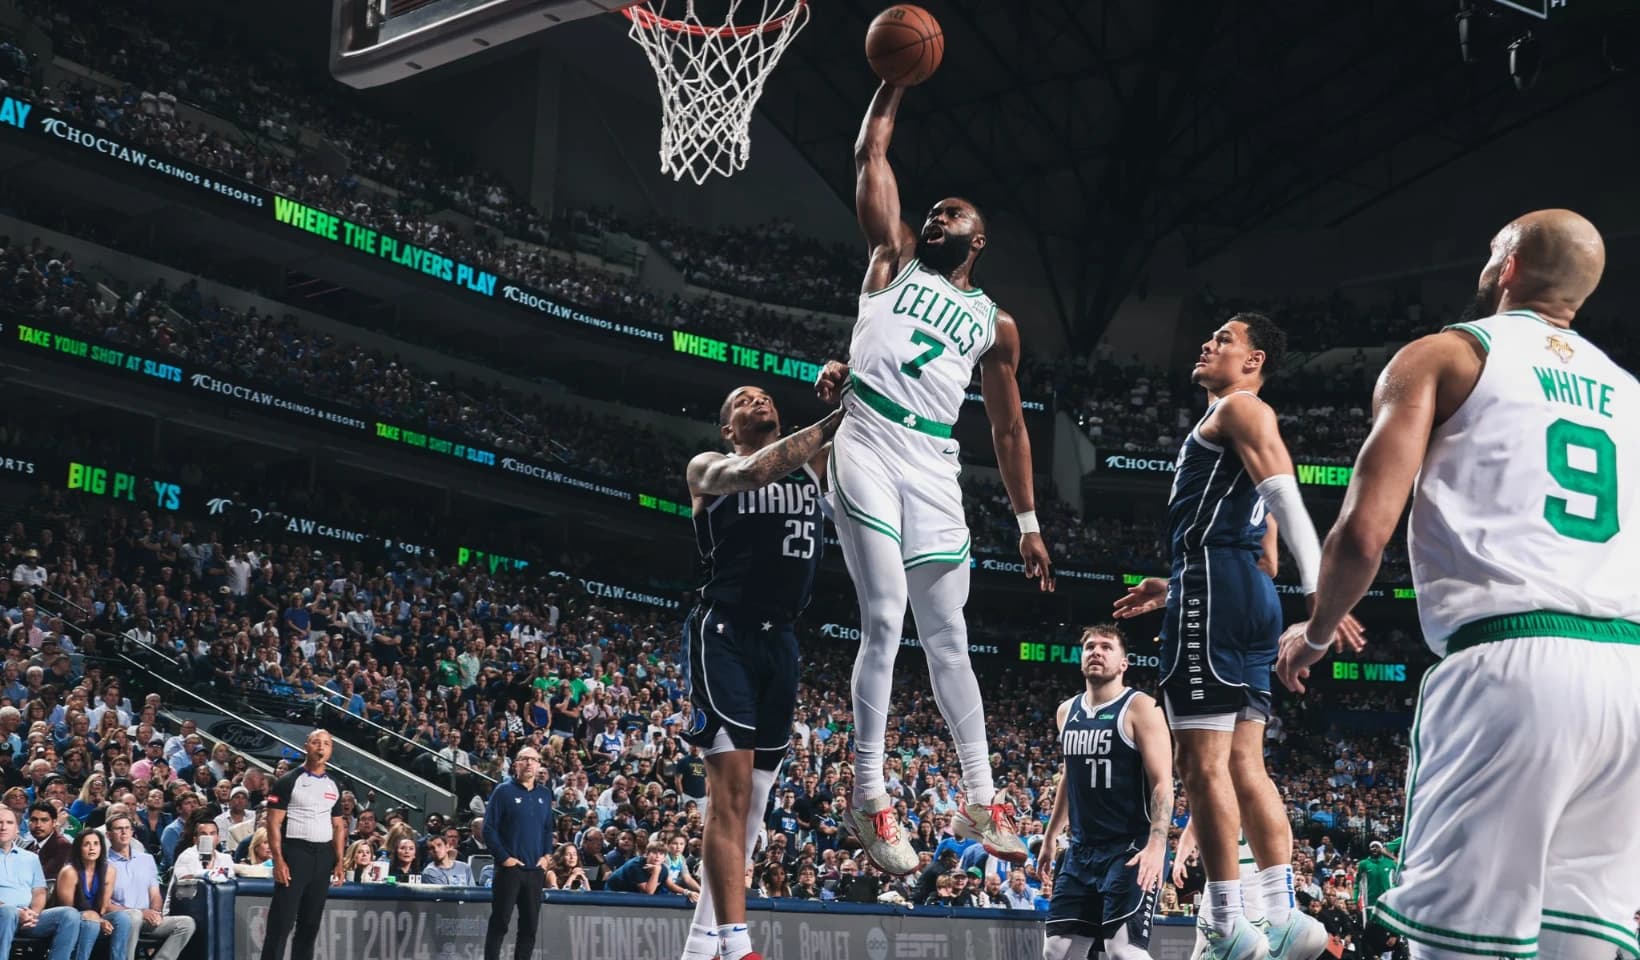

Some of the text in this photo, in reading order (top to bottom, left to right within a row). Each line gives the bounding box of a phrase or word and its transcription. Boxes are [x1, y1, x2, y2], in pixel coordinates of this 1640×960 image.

[52, 119, 264, 208] CHOCTAW CASINOS & RESORTS
[274, 196, 498, 297] WHERE THE PLAYERS PLAY
[509, 286, 573, 320] CHOCTAW
[572, 312, 613, 330] CASINOS
[622, 325, 664, 342] RESORTS
[892, 283, 983, 357] CELTICS
[18, 325, 51, 348] TAKE
[54, 335, 88, 358] YOUR
[91, 345, 124, 367] SHOT
[126, 355, 141, 371] AT
[143, 359, 183, 383] SLOTS
[672, 330, 821, 384] WHERE THE PLAYER
[900, 328, 946, 380] 7
[199, 375, 274, 406] CHOCTAW
[274, 398, 316, 417] CASINOS
[325, 412, 366, 430] RESORTS
[1533, 366, 1616, 419] WHITE
[67, 462, 107, 495] BIG
[113, 472, 181, 511] PLYS
[506, 458, 563, 483] CHOCTAW
[1114, 455, 1177, 473] CHOCTA
[1543, 418, 1621, 544] 9
[317, 525, 365, 543] CASINO
[782, 519, 816, 559] 25
[625, 591, 664, 607] CASINOS
[1020, 642, 1083, 664] BIG PLA
[1333, 661, 1407, 682] BIG WINS
[1064, 729, 1113, 756] MAVS
[1085, 758, 1112, 789] 77
[312, 909, 358, 960] AFT
[362, 910, 430, 960] 2024
[800, 921, 832, 960] 8PM
[895, 933, 948, 958] ESPN
